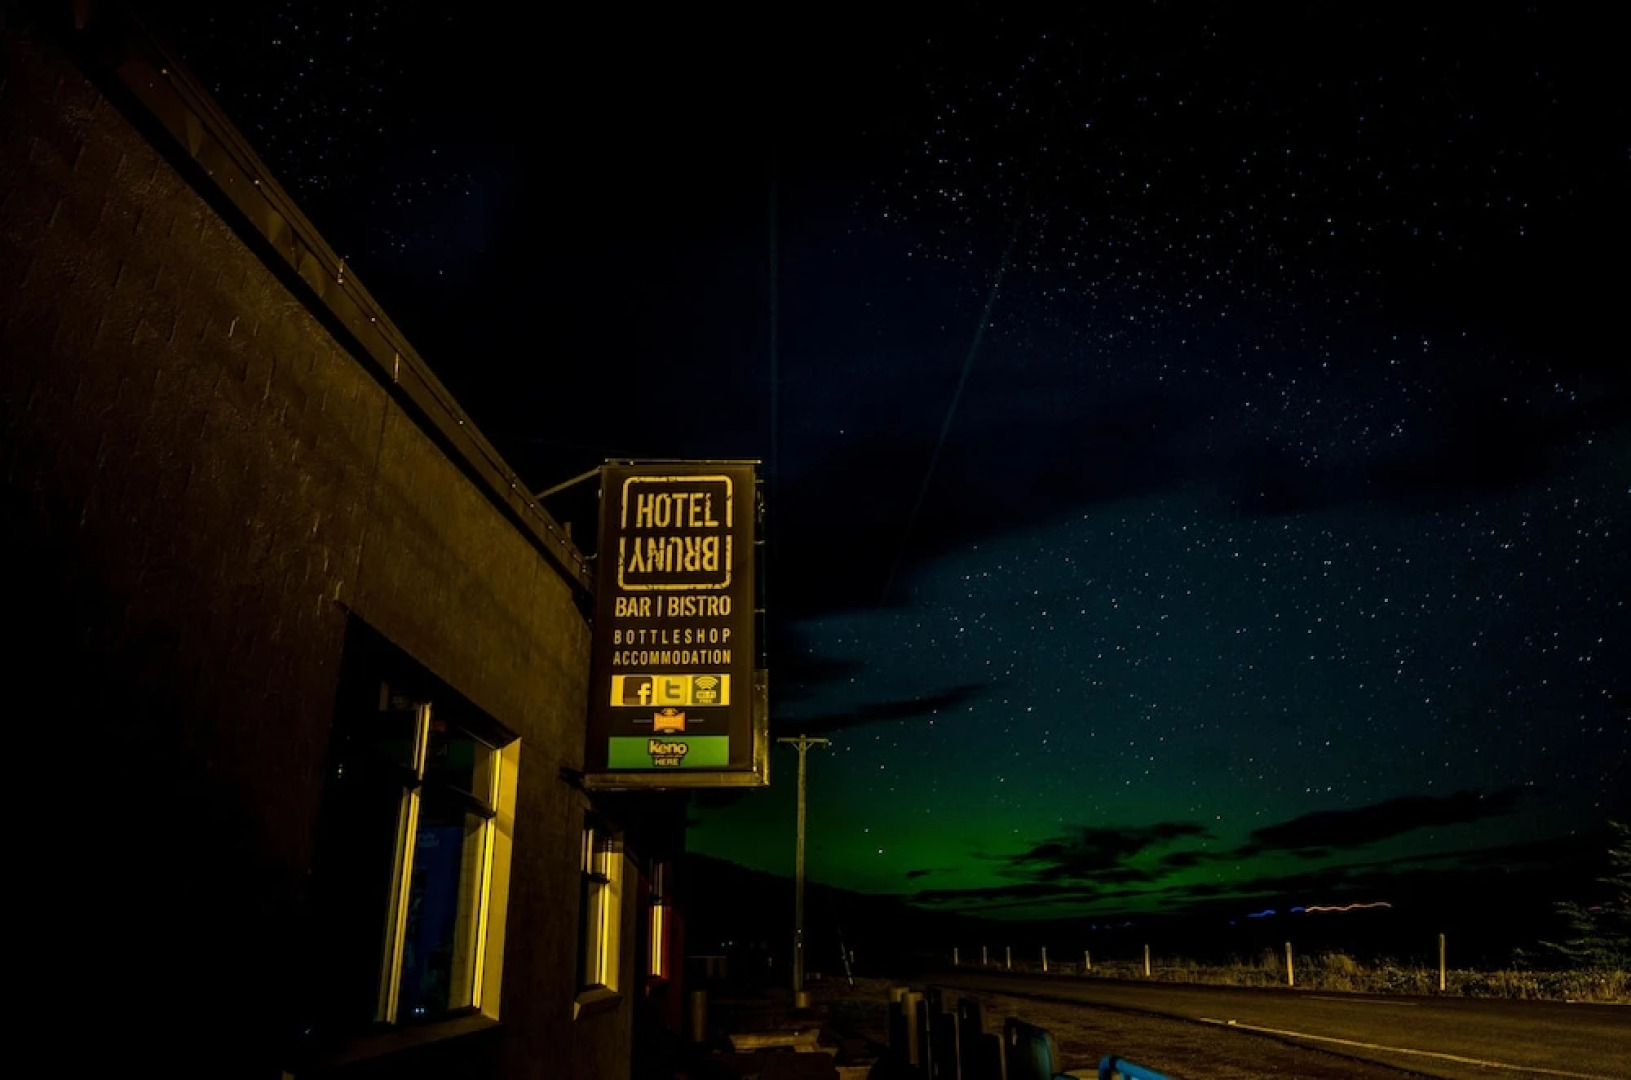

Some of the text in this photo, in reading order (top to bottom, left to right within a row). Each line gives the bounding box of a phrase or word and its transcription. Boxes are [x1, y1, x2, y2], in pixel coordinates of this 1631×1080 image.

[637, 493, 718, 527] HOTEL
[628, 537, 719, 572] BRUNY
[615, 596, 651, 617] BAR
[667, 595, 731, 617] BISTRO
[614, 627, 731, 644] BOTTLESHOP
[613, 649, 731, 665] ACCOMMODATION
